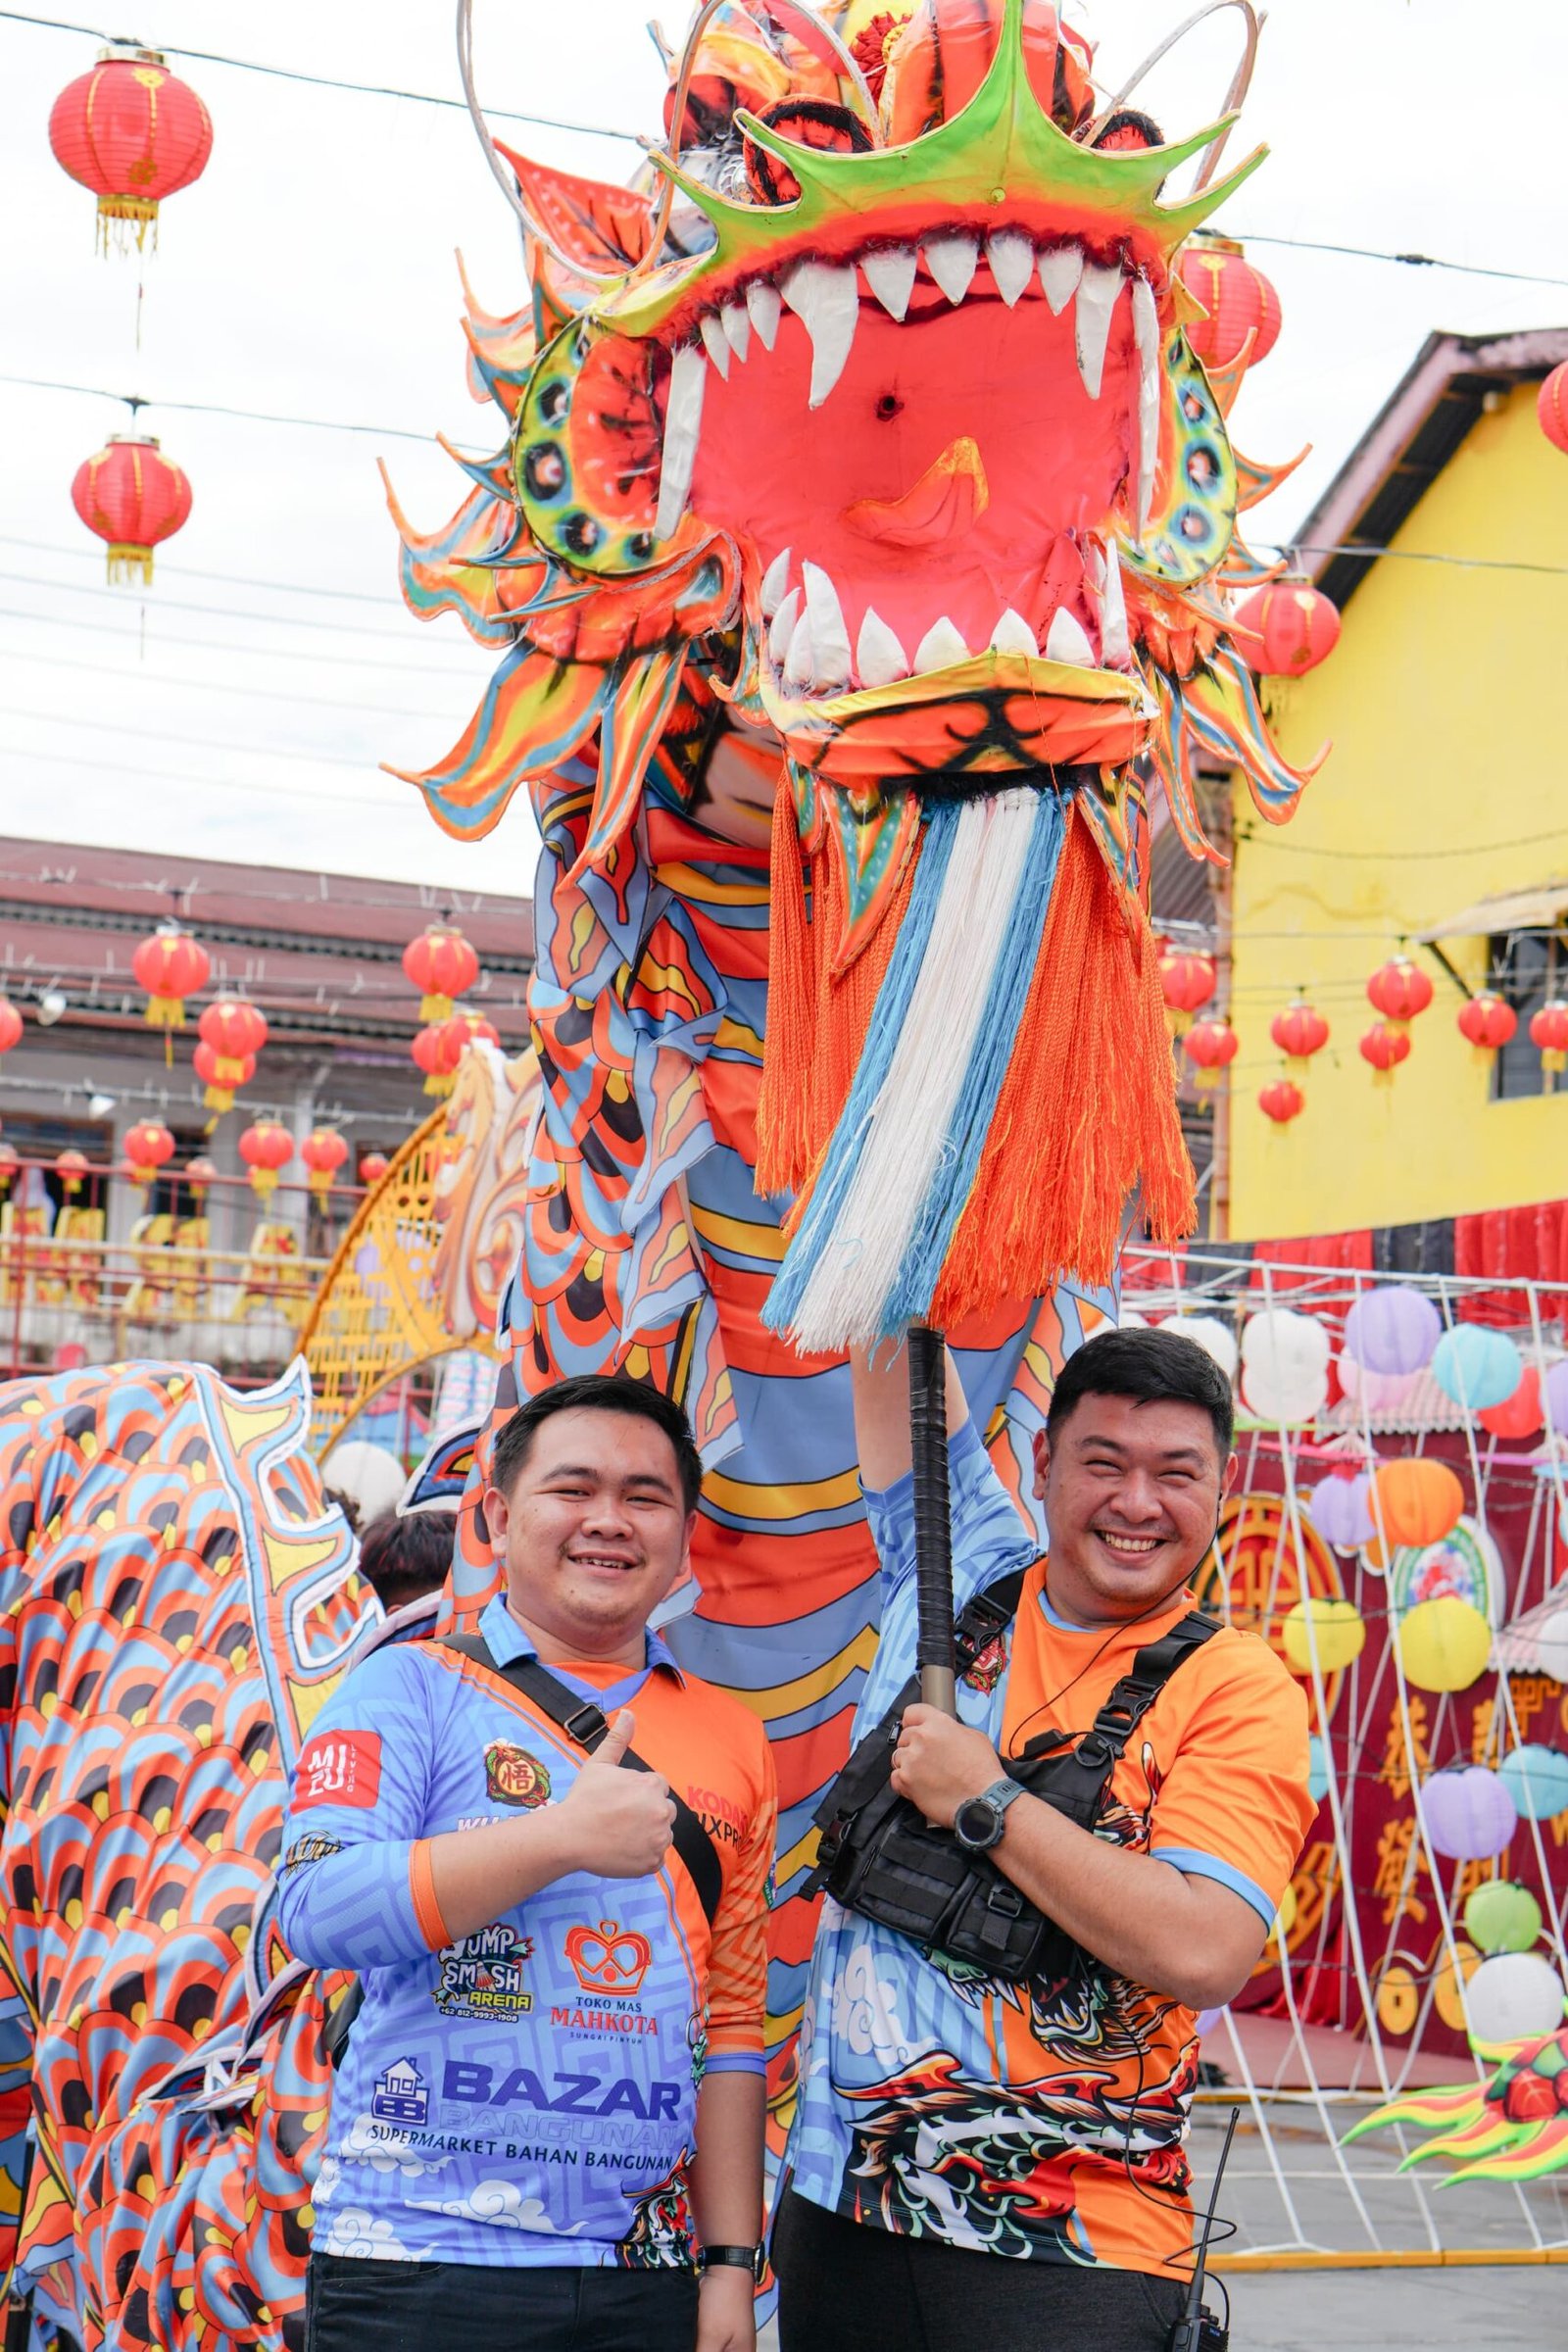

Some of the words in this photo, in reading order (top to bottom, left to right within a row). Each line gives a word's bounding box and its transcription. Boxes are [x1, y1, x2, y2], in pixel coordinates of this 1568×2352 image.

[501, 1763, 533, 1790] 悟
[469, 1990, 531, 2010] ARENA
[575, 1996, 612, 2010] TOKO
[616, 2000, 642, 2013] MAS
[550, 2006, 659, 2035] MAHKOTA
[569, 2031, 608, 2041] SUNGAI
[442, 2059, 681, 2122] BAZAR
[440, 2103, 678, 2150] BANGUNAN
[370, 2124, 498, 2157] SUPERMARKET
[506, 2143, 578, 2166] BAHAN
[584, 2151, 673, 2171] BANGUNAN
